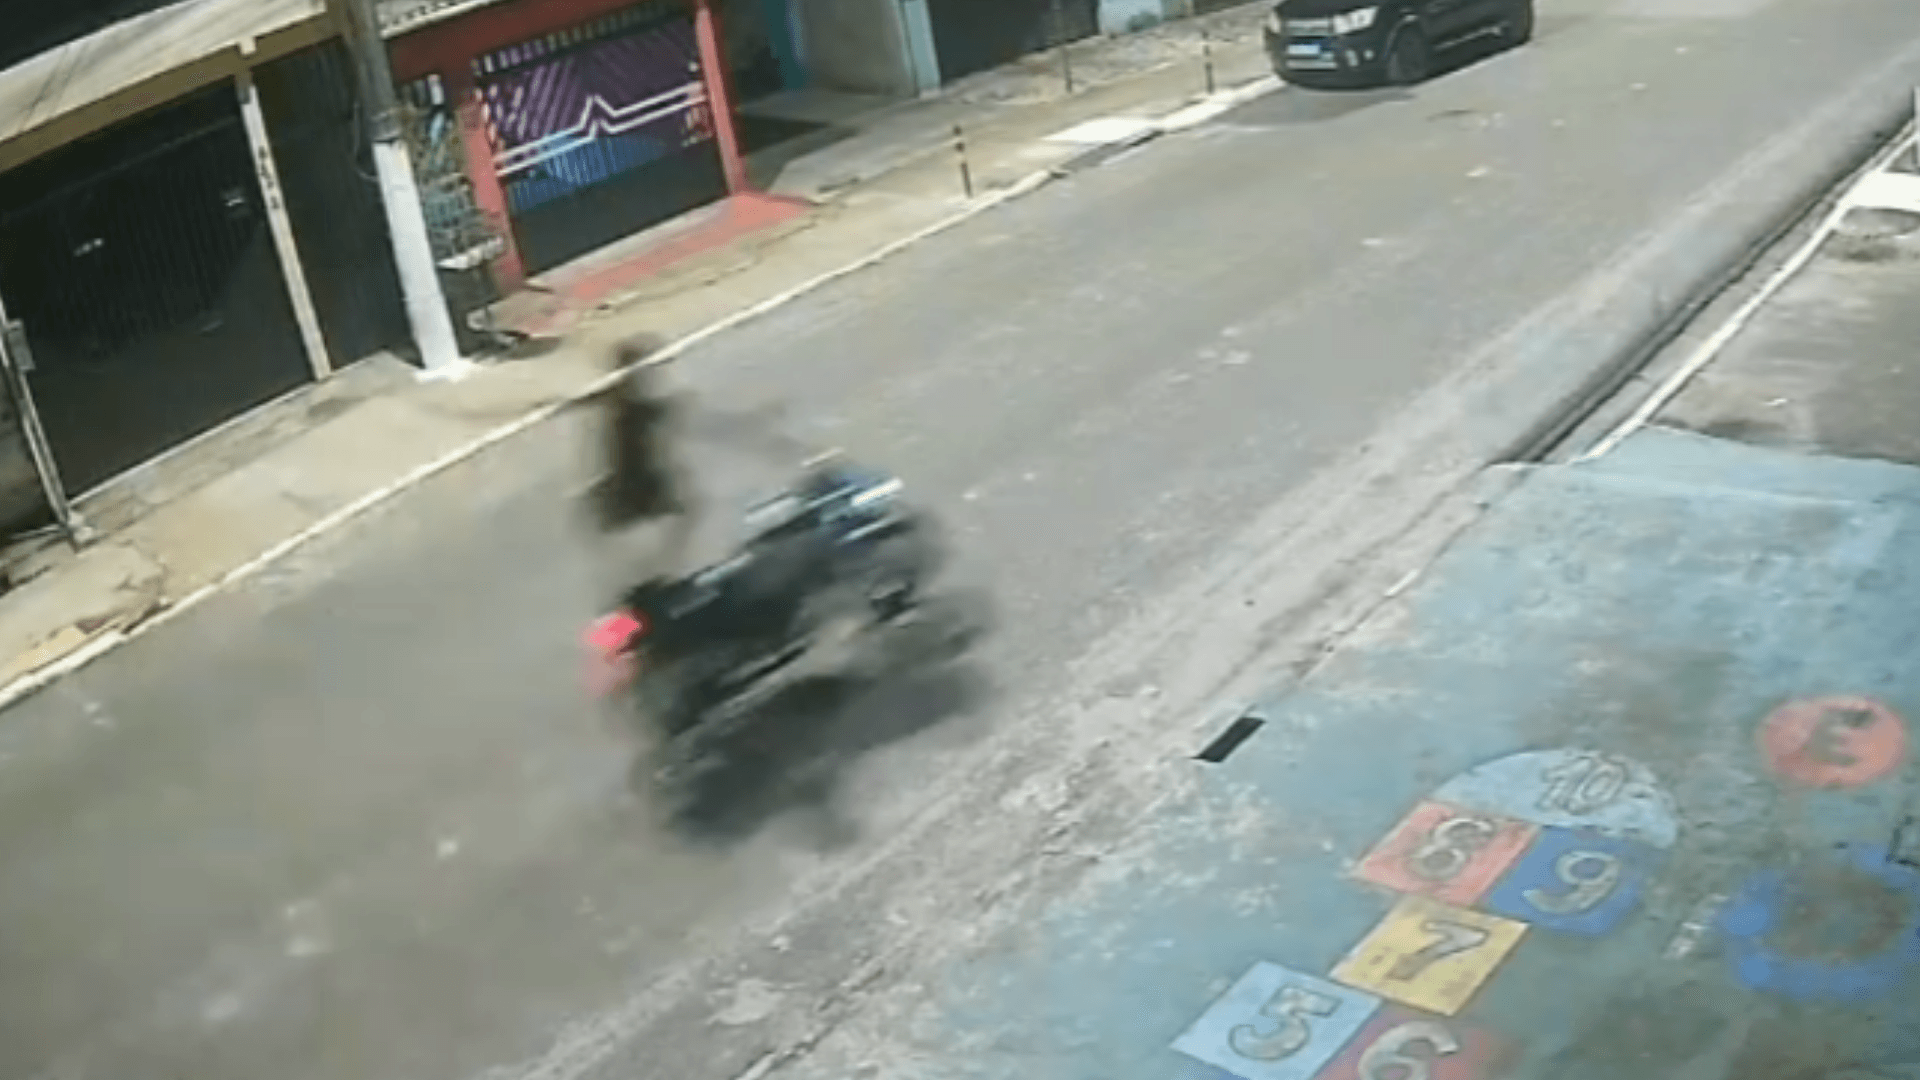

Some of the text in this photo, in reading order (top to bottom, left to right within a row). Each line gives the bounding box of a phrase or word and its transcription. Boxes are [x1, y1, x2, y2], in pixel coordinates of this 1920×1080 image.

[1535, 753, 1624, 816] 10
[1410, 817, 1497, 880] 8
[1522, 850, 1622, 914] 9
[1385, 918, 1489, 982] 7
[1228, 983, 1345, 1062] 5
[1357, 1019, 1461, 1080] 6
